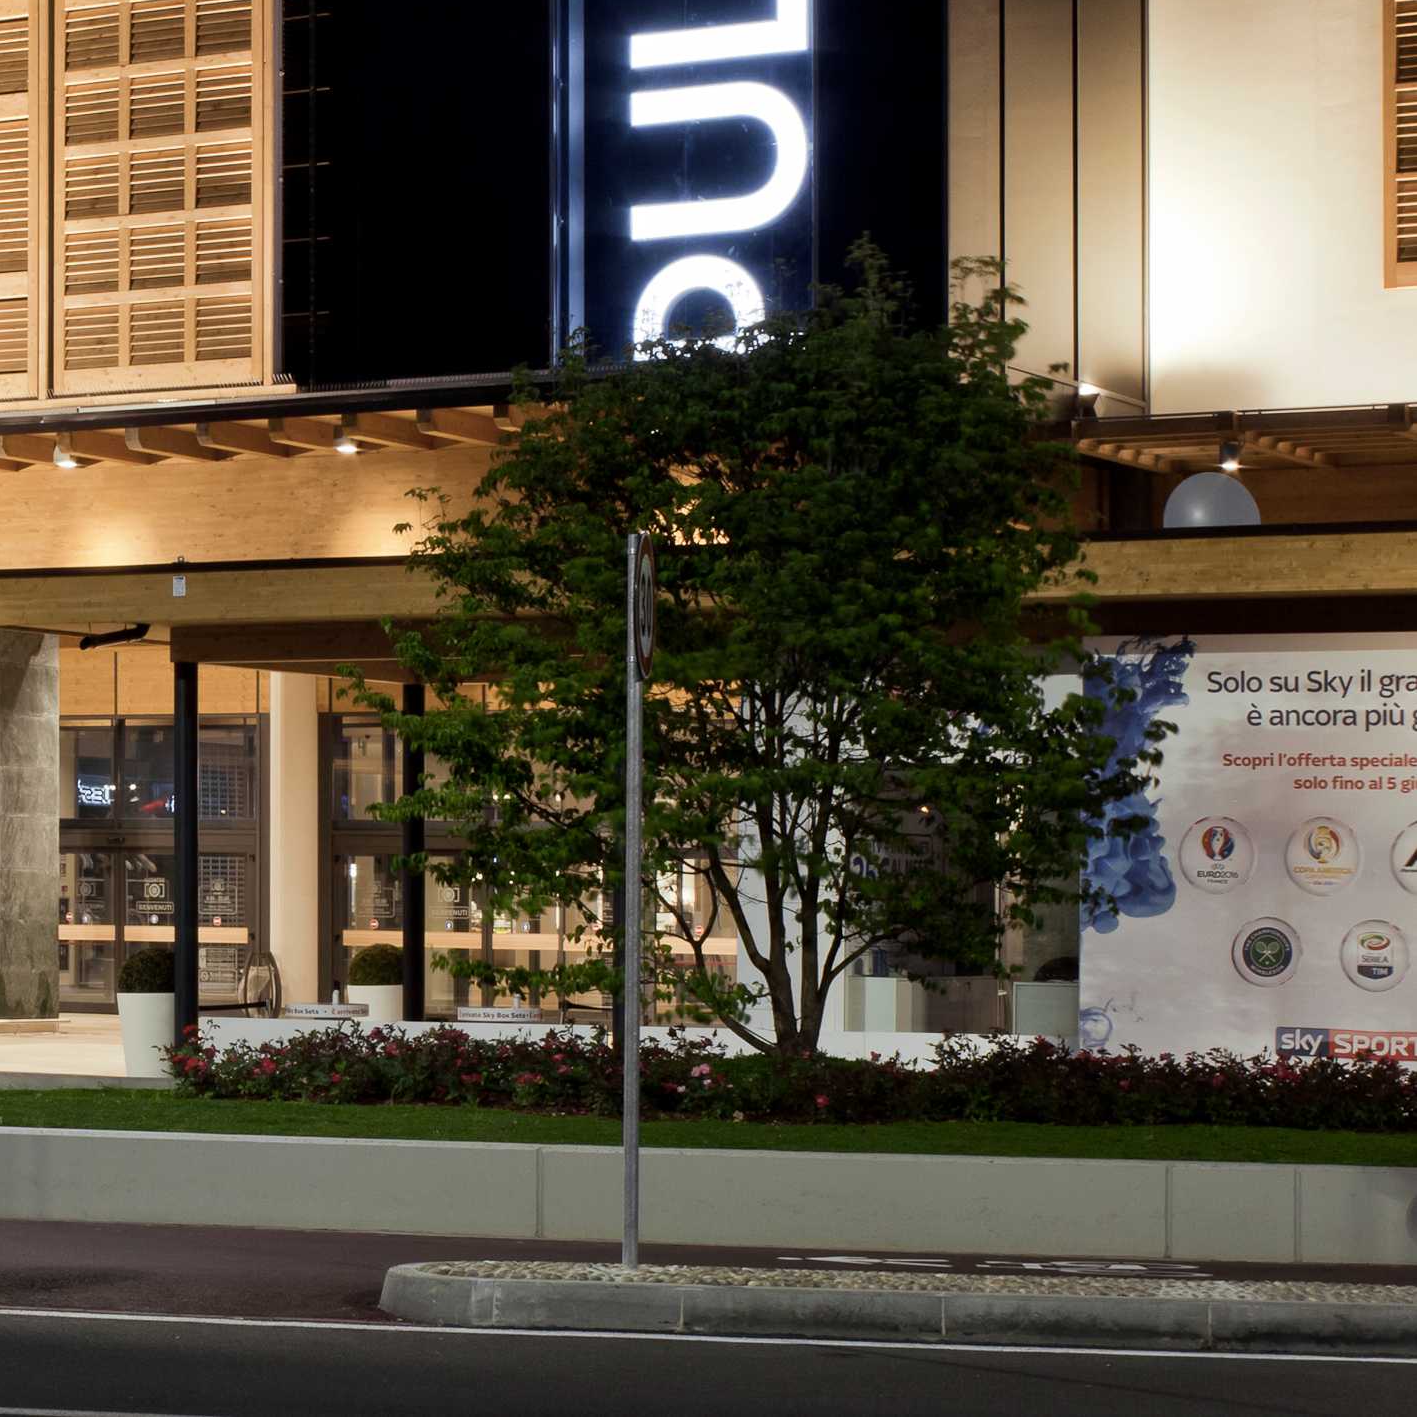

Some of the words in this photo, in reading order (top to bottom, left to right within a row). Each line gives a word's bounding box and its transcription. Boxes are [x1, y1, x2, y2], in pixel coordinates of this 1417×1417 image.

[1207, 670, 1263, 693] Solo
[1269, 675, 1299, 693] su
[1306, 670, 1352, 698] Sky
[1359, 669, 1371, 692] il
[1246, 703, 1262, 726] è
[1269, 708, 1357, 726] ancora
[1365, 702, 1405, 732] più
[1222, 753, 1274, 770] Scopri
[1279, 753, 1346, 767] l'offerta
[1351, 753, 1417, 770] speciale
[1293, 776, 1328, 790] solo
[1332, 776, 1364, 790] fino
[1368, 776, 1382, 790] al
[1387, 777, 1396, 790] 5
[1400, 776, 1417, 794] gi
[1281, 1029, 1324, 1056] sky
